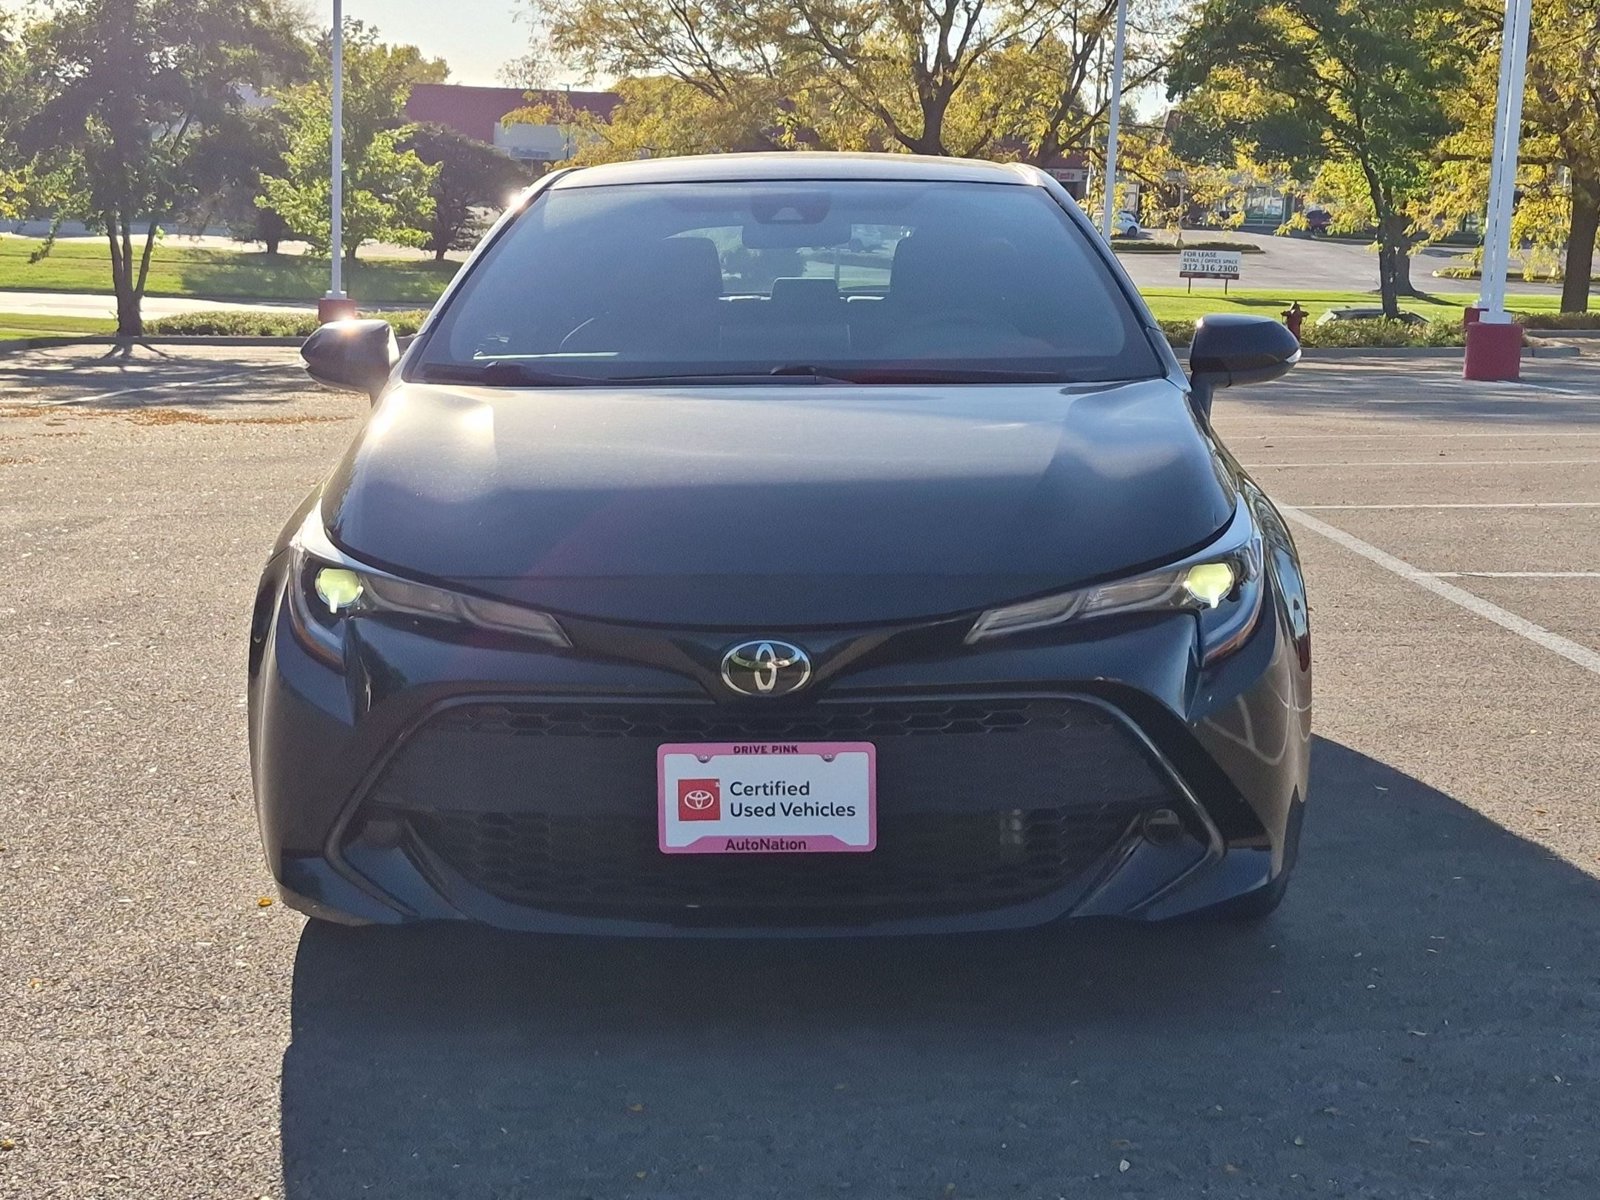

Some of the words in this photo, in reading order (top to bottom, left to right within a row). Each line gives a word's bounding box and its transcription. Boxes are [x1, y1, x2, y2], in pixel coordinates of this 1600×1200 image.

[1182, 263, 1238, 273] 312.316.2300
[733, 745, 767, 754] DRIVE
[771, 744, 799, 754] PINK
[729, 780, 811, 797] Certified
[729, 802, 776, 818] Used
[779, 801, 857, 818] Vehicles
[724, 838, 807, 851] AutoNation
